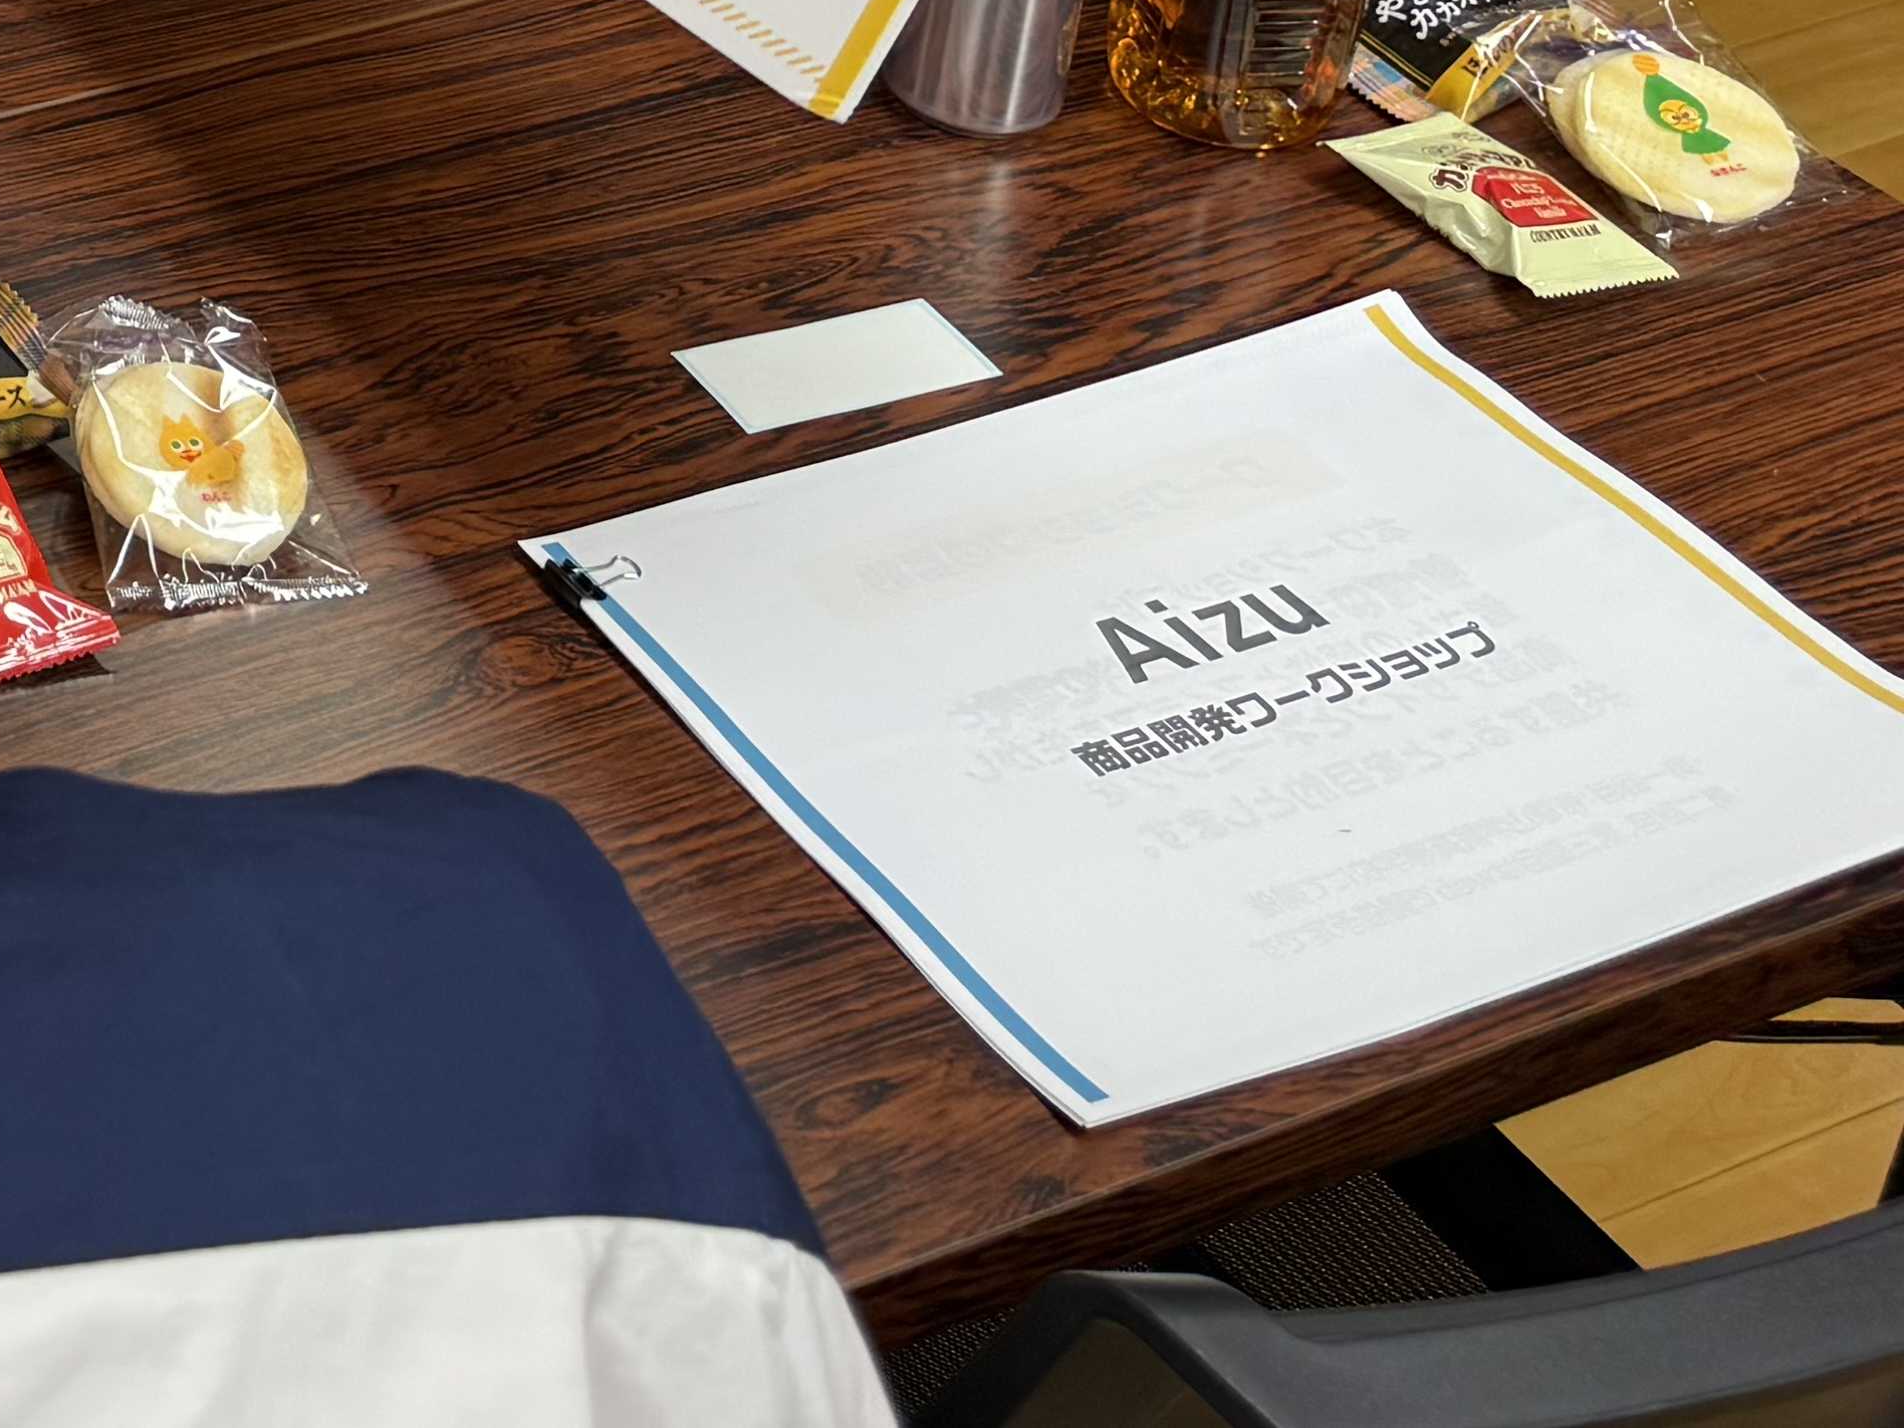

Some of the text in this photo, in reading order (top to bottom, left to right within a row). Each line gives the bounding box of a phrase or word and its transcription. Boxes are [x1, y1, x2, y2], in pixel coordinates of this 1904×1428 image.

[1096, 584, 1330, 684] Aizu
[1071, 620, 1495, 777] 商品開発ワークショップ
